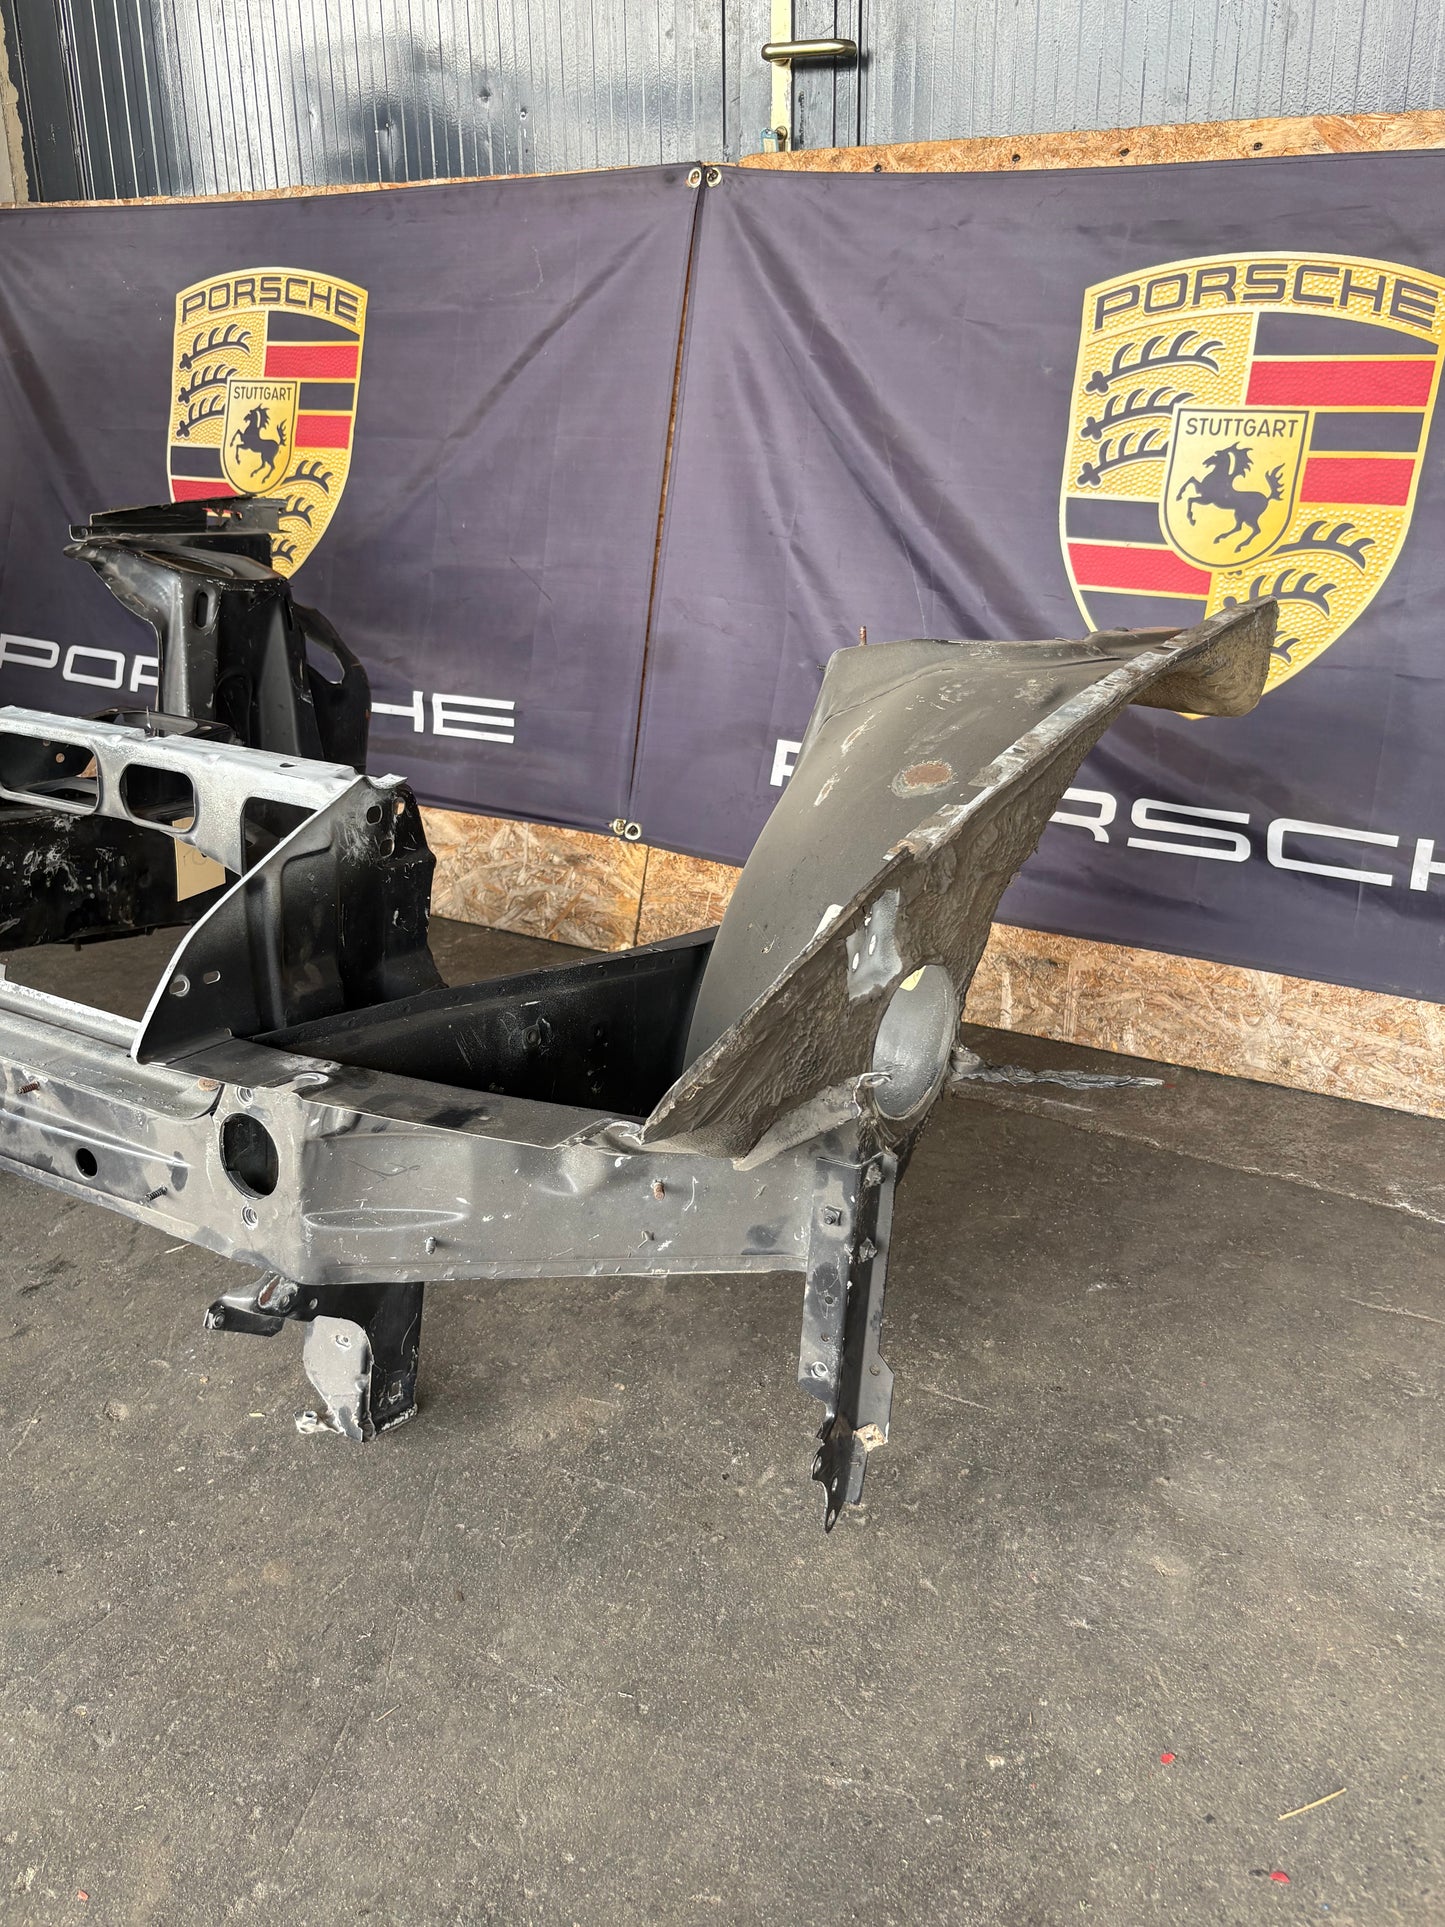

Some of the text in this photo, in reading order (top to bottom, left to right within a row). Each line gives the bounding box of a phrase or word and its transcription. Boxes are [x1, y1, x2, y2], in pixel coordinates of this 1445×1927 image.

[181, 276, 359, 324] PORSCHE
[1094, 263, 1439, 334] PORSCHE
[233, 386, 293, 401] STUTTGART
[1185, 417, 1299, 439] STUTTGART
[0, 633, 516, 744] POHE
